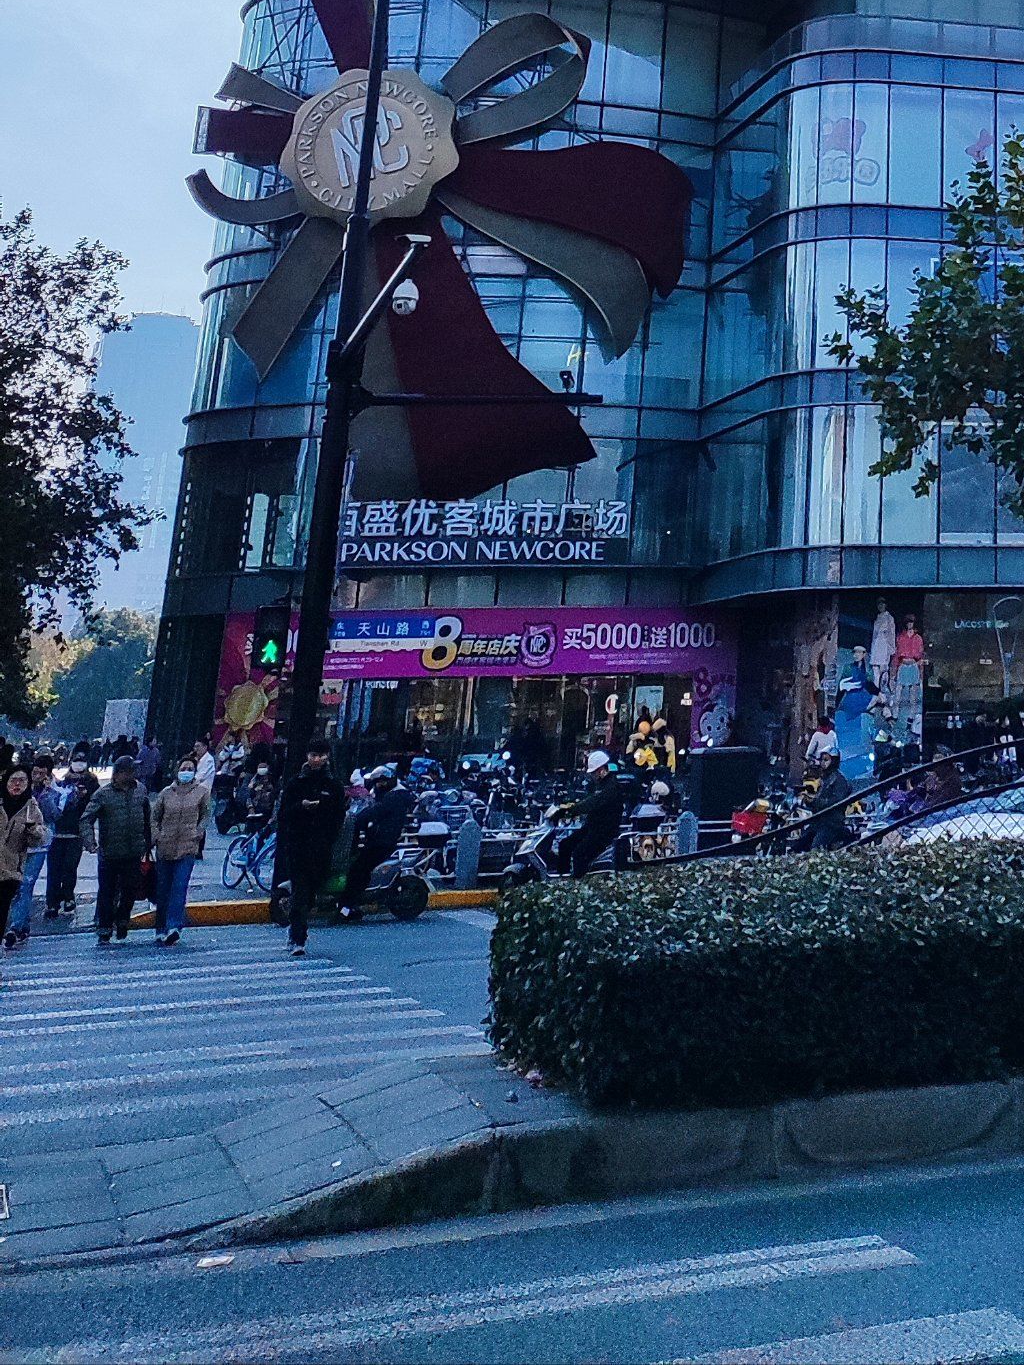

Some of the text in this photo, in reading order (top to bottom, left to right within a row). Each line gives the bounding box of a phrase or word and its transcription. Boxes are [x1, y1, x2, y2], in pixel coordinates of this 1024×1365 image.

[297, 80, 439, 179] PARKSON NWCORE
[382, 154, 435, 206] MALL
[340, 539, 605, 563] PARKSON NEWCORE
[356, 621, 410, 637] 天山路
[562, 622, 642, 650] 买5000
[650, 621, 716, 648] 送1000
